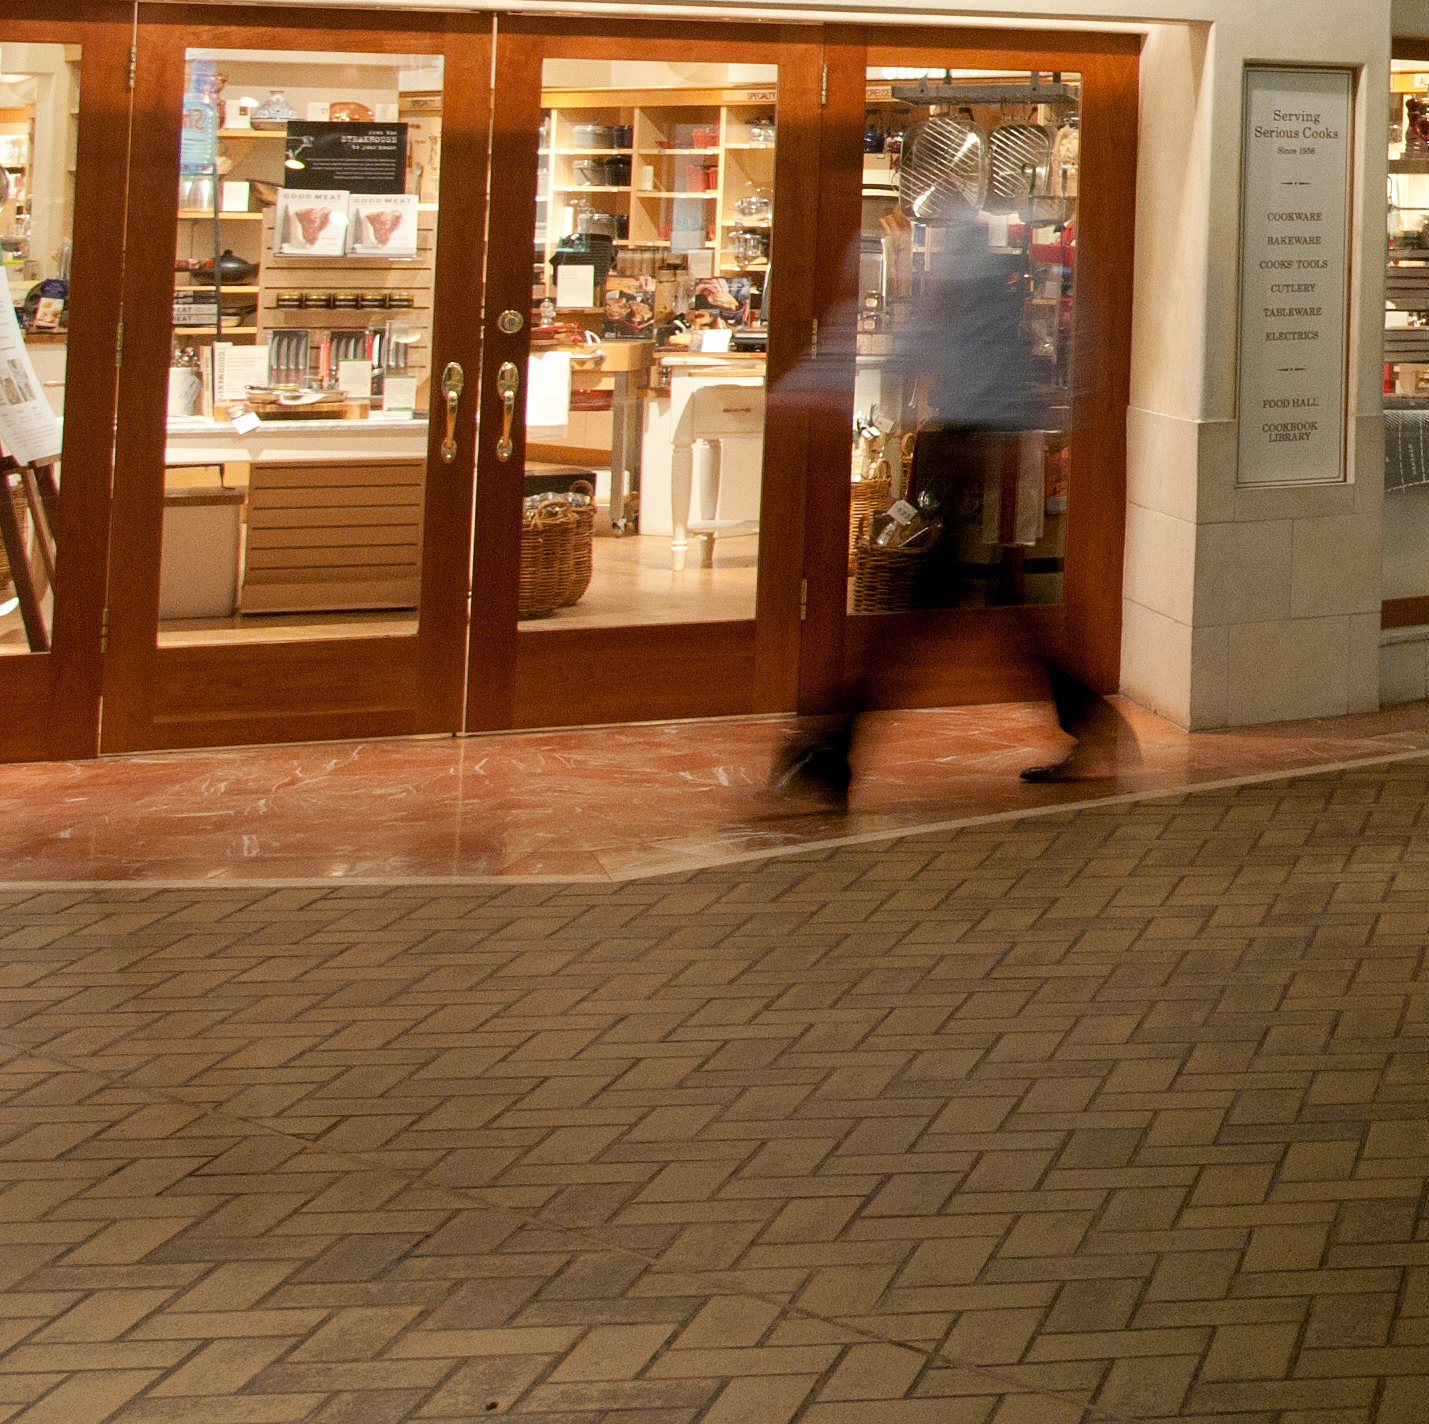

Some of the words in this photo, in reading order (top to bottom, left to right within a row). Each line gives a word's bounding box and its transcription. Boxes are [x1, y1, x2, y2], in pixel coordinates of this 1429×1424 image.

[1273, 109, 1321, 124] Serving
[1254, 126, 1299, 139] Serious
[1302, 127, 1339, 140] Cooks
[1277, 146, 1297, 155] Since
[1267, 212, 1323, 221] COOKWARE
[1267, 236, 1322, 245] BAKEWARE
[1296, 260, 1328, 269] TOOLS
[1270, 284, 1316, 294] CUTLERY
[1263, 308, 1322, 317] TABLEWARE
[1265, 332, 1319, 342] ELECTRICS
[1263, 399, 1290, 409] FOOD
[1292, 398, 1319, 408] HALL
[1262, 422, 1318, 433] COOKBOOK
[1268, 433, 1311, 443] LIBRARY
